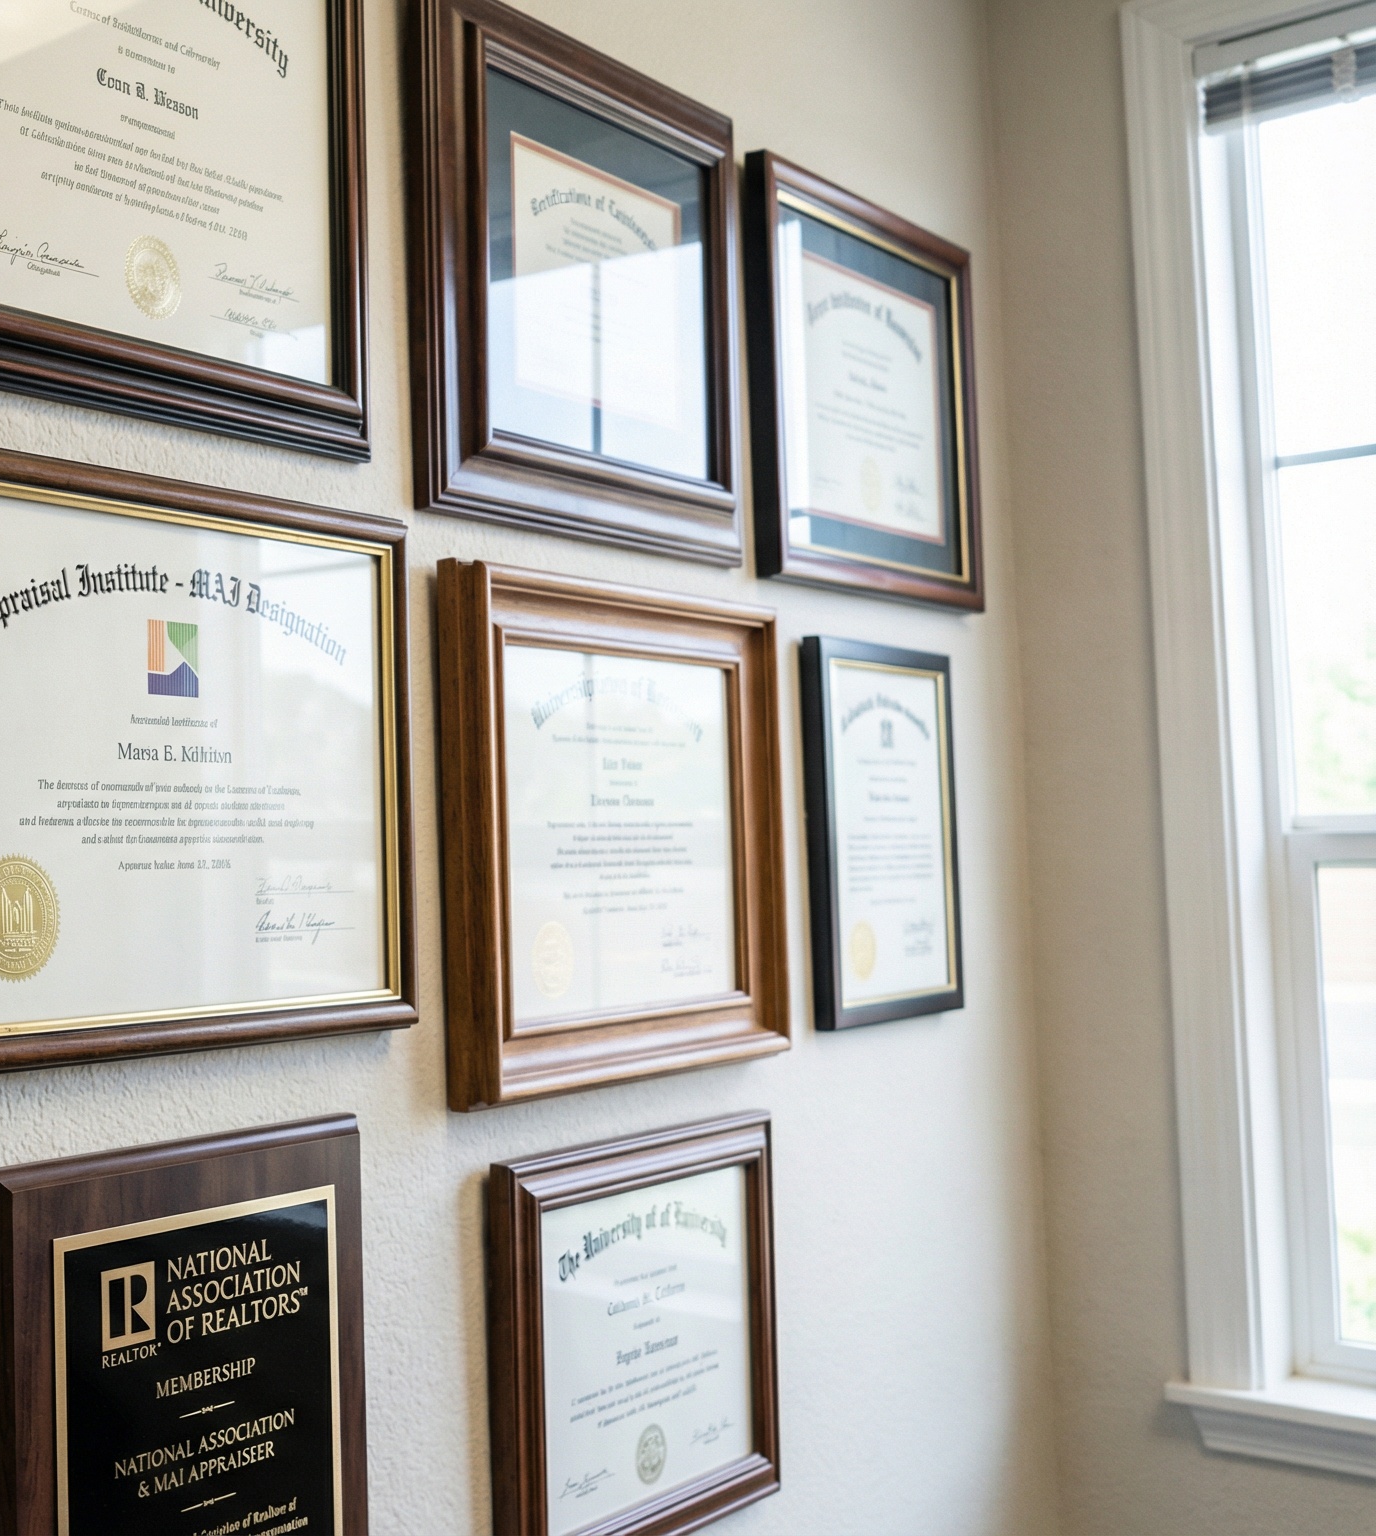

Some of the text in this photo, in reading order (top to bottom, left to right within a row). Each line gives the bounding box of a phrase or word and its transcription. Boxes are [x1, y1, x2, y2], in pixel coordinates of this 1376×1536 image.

[199, 0, 289, 78] niversity
[75, 563, 170, 598] Institute
[245, 582, 347, 666] Designation
[167, 1238, 272, 1283] NATIONAL
[558, 1248, 581, 1282] The
[166, 1260, 302, 1314] ASSOCIATION
[166, 1316, 195, 1345] OF
[156, 1357, 256, 1399] MEMBERSHIP
[114, 1408, 296, 1479] NATIONAL ASSOCIATION
[137, 1480, 150, 1499] &
[154, 1467, 185, 1495] MAI
